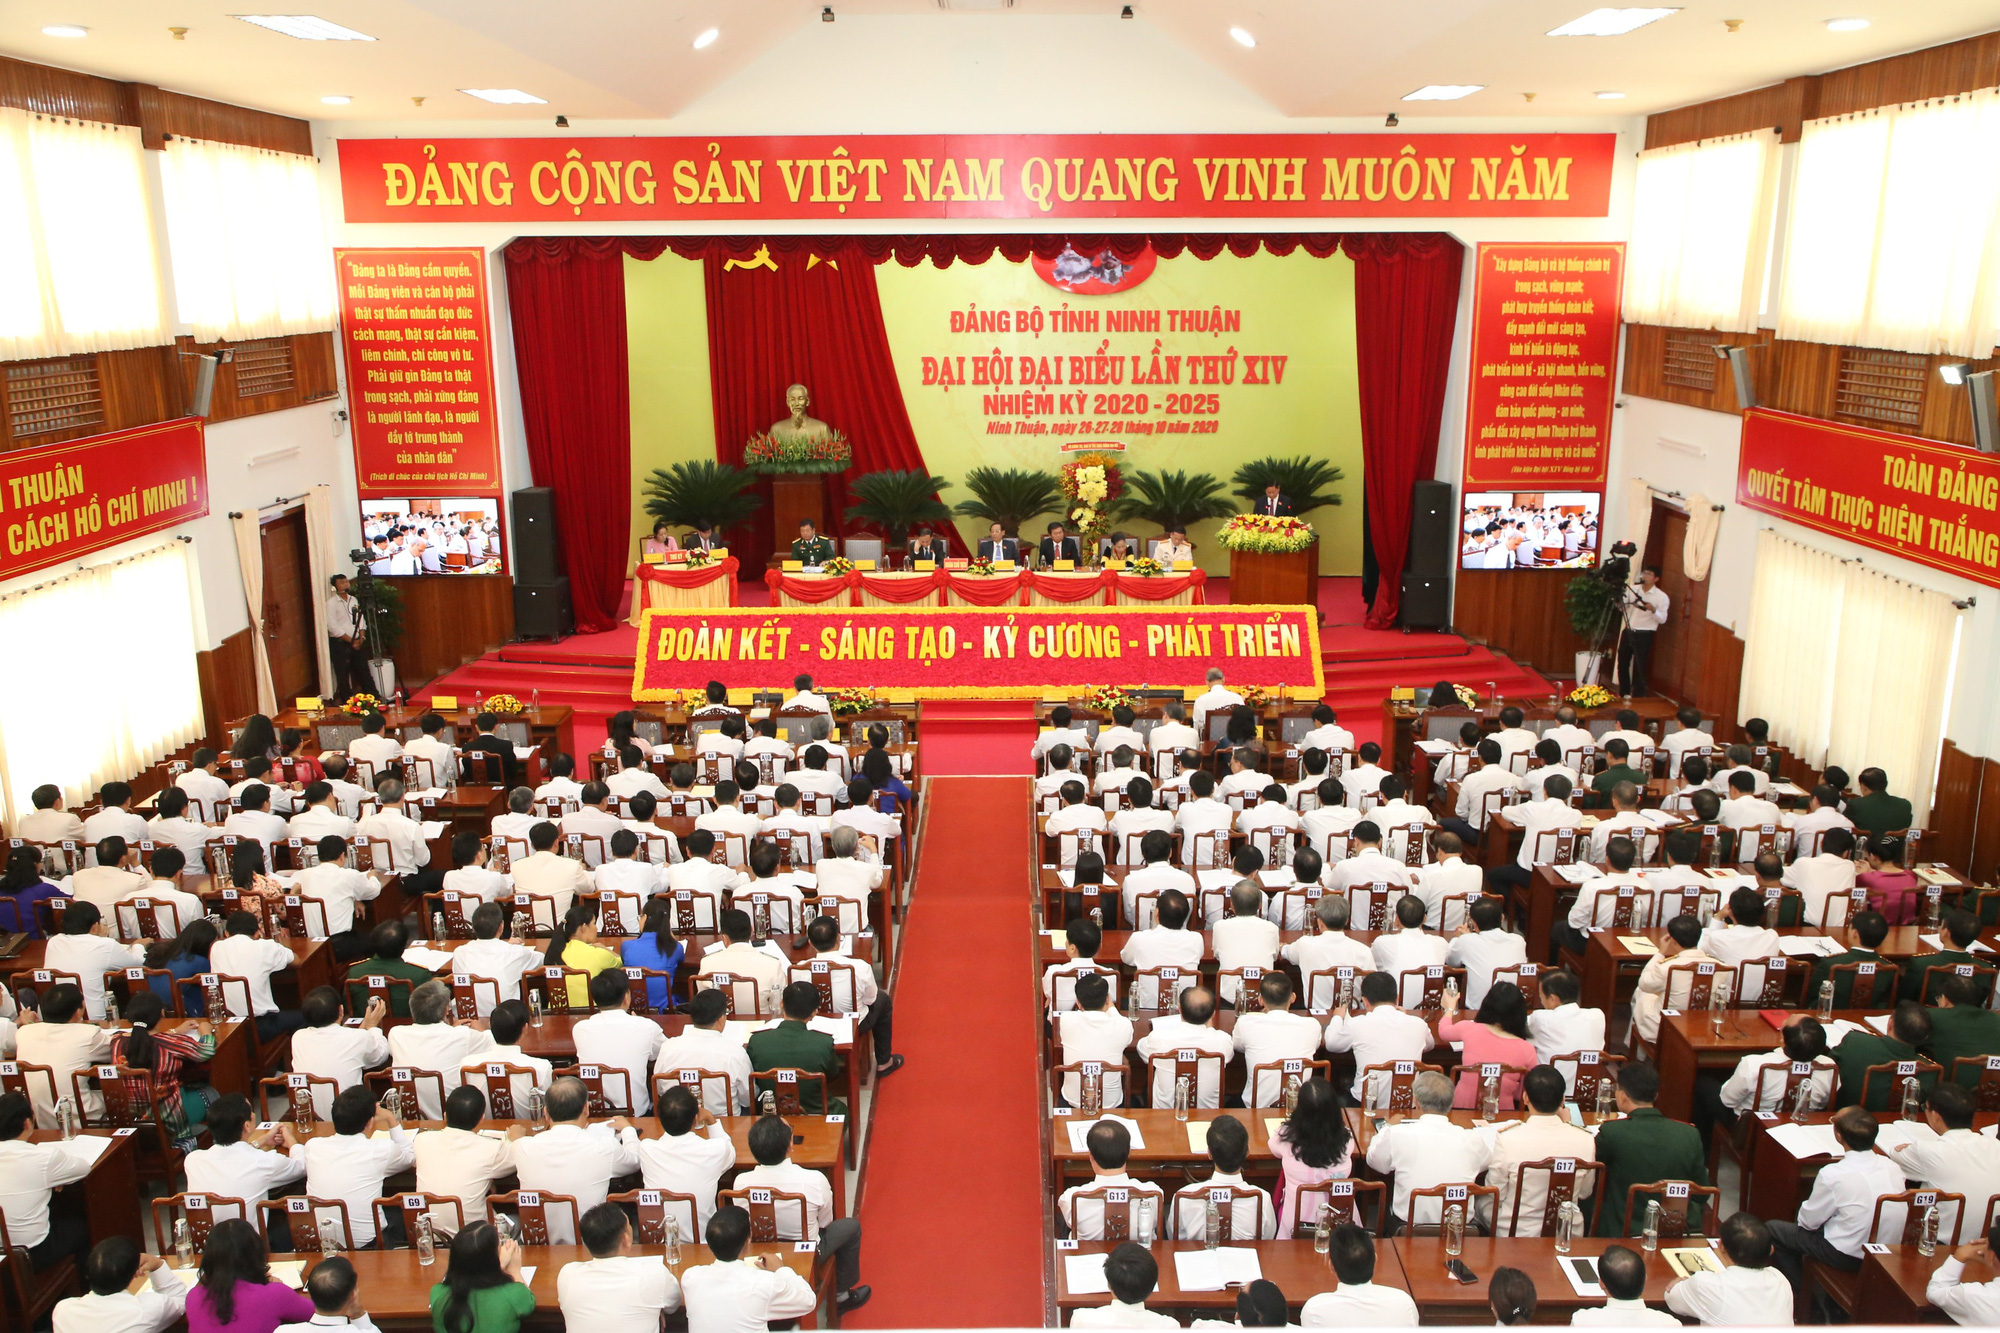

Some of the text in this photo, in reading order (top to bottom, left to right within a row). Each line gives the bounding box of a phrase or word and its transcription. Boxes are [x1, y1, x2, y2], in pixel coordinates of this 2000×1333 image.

[383, 143, 1572, 215] ĐẢNG CỘNG SẢN VIỆT NAM QUANG VINH MUÔN NĂM
[377, 266, 385, 276] ta
[388, 265, 396, 276] là
[398, 263, 420, 278] Đảng
[422, 262, 441, 276] cầm
[444, 262, 472, 278] quyền.
[348, 284, 474, 300] Mỗi Đảng viên và cán bộ phải
[355, 305, 472, 322] thật sự thấm nhuần đạo đức
[950, 303, 1240, 338] ĐẢNG BỘ TỈNH NINH THUẬN
[353, 326, 478, 343] cách mạng, thật sự cần kiệm,
[362, 349, 474, 362] liêm chính, chí công vô tư.
[922, 339, 1287, 392] ĐẠI HỘI ĐẠI BIỂU LẦN THỨ XIV
[368, 368, 472, 384] Phải giữ gìn Đảng ta thật
[365, 389, 478, 405] trong sạch, phải xứng đáng
[984, 388, 1054, 418] NHIỆM
[1060, 390, 1087, 414] KỲ
[1094, 394, 1148, 414] 2020
[1166, 394, 1219, 414] 2025
[368, 411, 479, 425] là người lãnh đạo, là người
[987, 421, 1011, 434] Ninh
[1014, 421, 1048, 436] Thuận,
[1052, 422, 1077, 436] ngày
[1125, 420, 1153, 436] tháng
[1156, 421, 1165, 433] 10
[1167, 421, 1189, 433] năm
[1192, 421, 1218, 433] 2020
[388, 429, 463, 444] đầy tớ trung thành
[397, 450, 412, 464] của
[415, 451, 435, 463] nhân
[9, 462, 84, 509] THUẬN
[1883, 453, 1999, 511] TOÀN ĐẢNG
[7, 513, 69, 556] CÁCH
[74, 493, 101, 537] HỒ
[107, 486, 138, 526] CHÍ
[142, 479, 187, 516] MINH
[1748, 468, 1999, 568] QUYẾT TÂM THỰC HIỆN THẮNG
[657, 619, 731, 661] ĐOÀN
[738, 615, 789, 660] KẾT
[820, 620, 894, 659] SÁNG
[906, 626, 956, 666] TẠO
[984, 611, 1023, 658] KỶ
[1029, 620, 1120, 658] CƯƠNG
[1147, 618, 1215, 656] PHÁT
[1220, 611, 1300, 656] TRIỂN
[777, 831, 789, 839] C11
[677, 891, 690, 900] D10
[1428, 968, 1442, 977] E17
[1398, 1064, 1411, 1072] F16
[1557, 1162, 1572, 1170] G17
[1110, 1192, 1125, 1200] G13
[1212, 1192, 1228, 1200] G14
[1335, 1185, 1350, 1193] G15
[1449, 1189, 1464, 1197] G16
[1669, 1186, 1686, 1195] G18
[521, 1196, 537, 1204] G10
[752, 1193, 768, 1201] G12
[293, 1202, 304, 1210] G8
